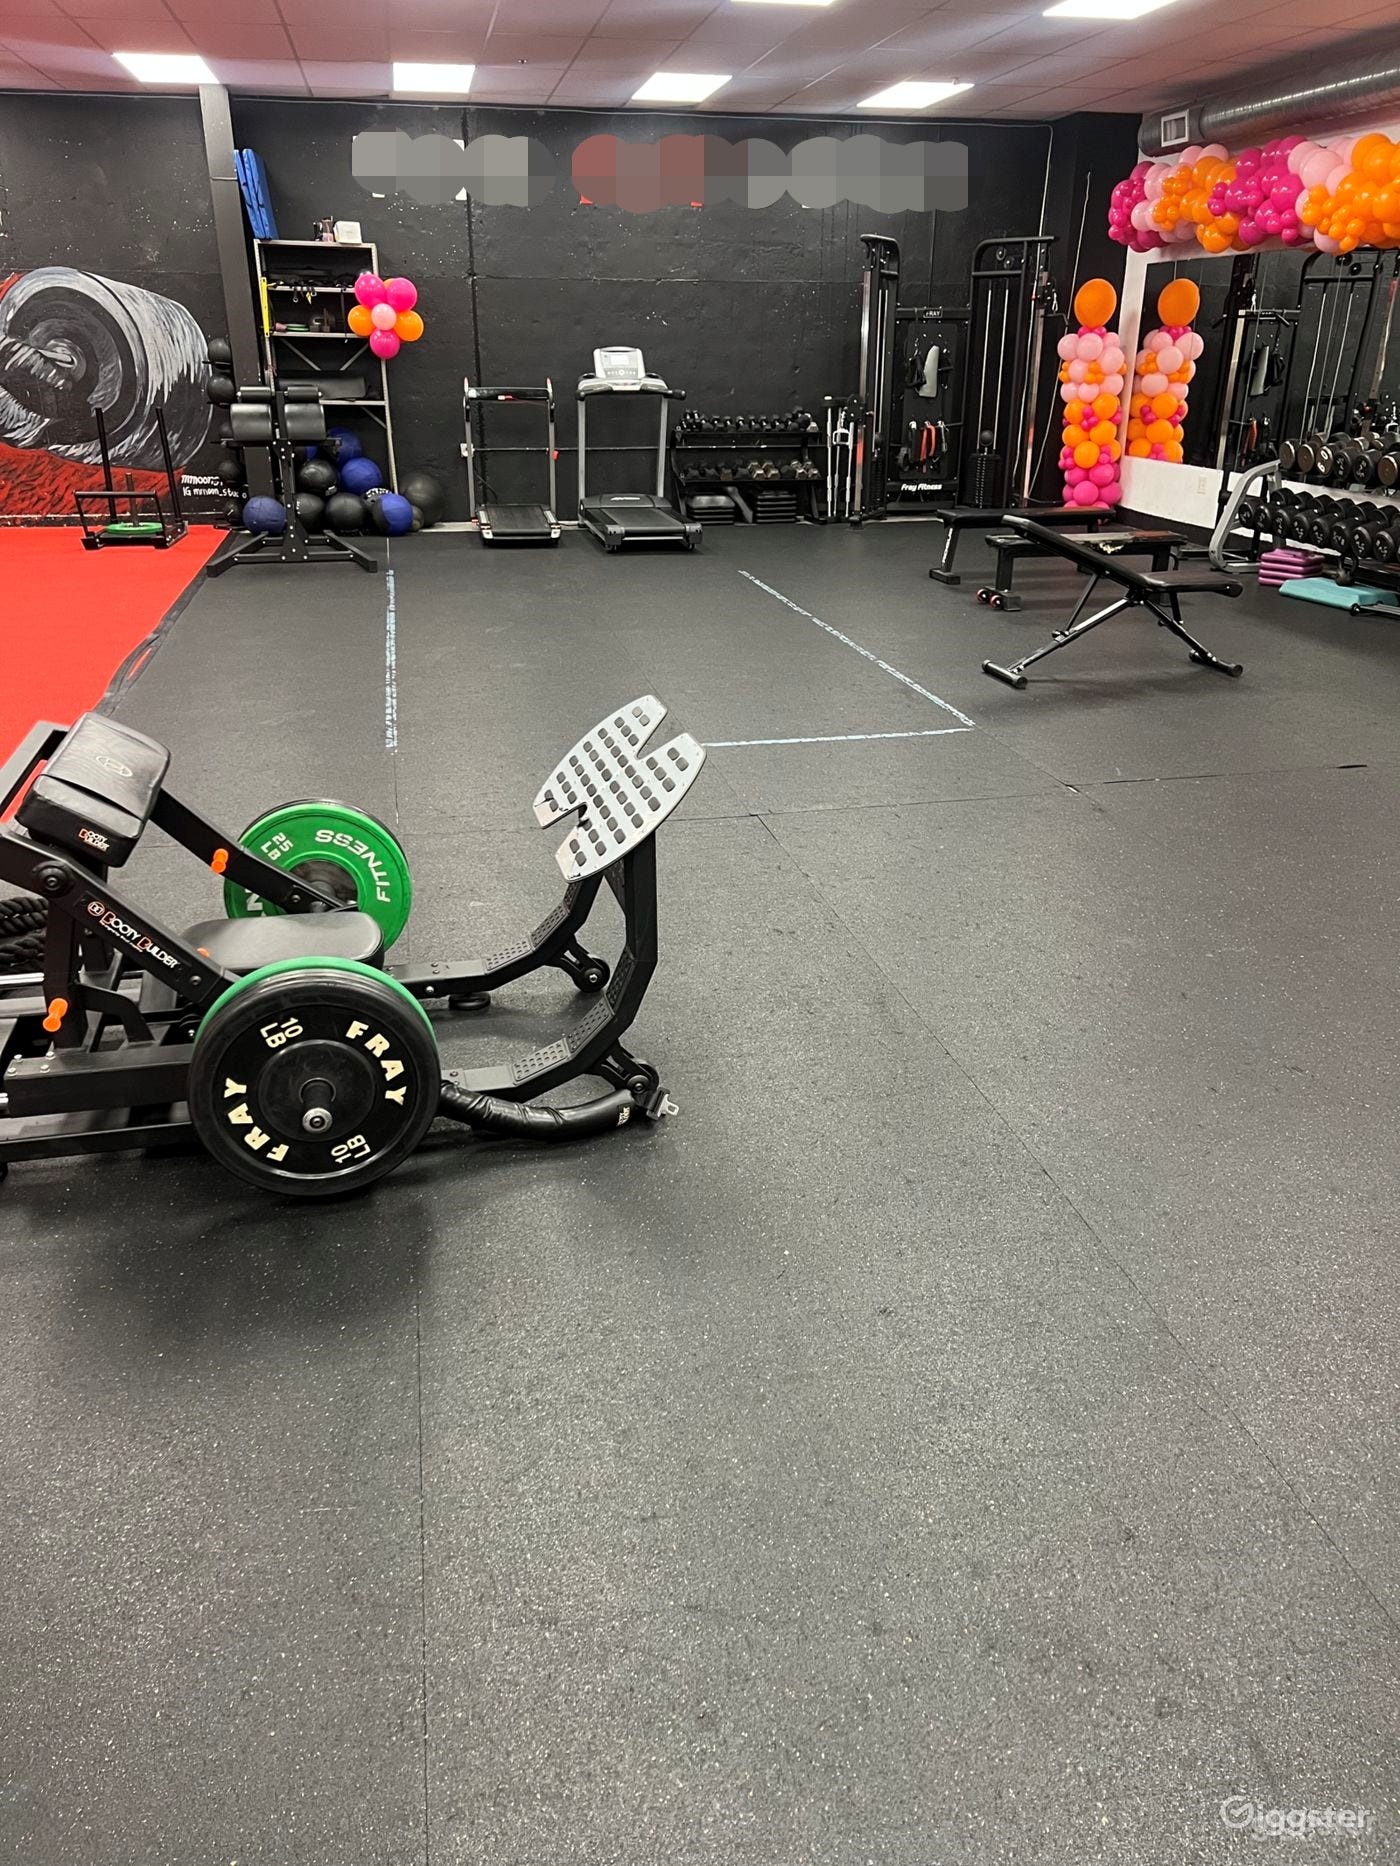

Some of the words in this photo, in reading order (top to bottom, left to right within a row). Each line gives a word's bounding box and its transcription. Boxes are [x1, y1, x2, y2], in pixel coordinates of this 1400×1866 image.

[260, 841, 281, 861] LB
[272, 832, 294, 852] 25
[315, 829, 391, 903] FITNESS
[101, 911, 141, 941] BOOTY
[137, 937, 179, 969] BUILDER
[260, 1022, 287, 1048] LB
[280, 1017, 303, 1038] 10
[345, 1020, 407, 1106] FRAY
[224, 1077, 290, 1162] FRAY
[330, 1143, 352, 1164] 10
[346, 1134, 371, 1158] LB
